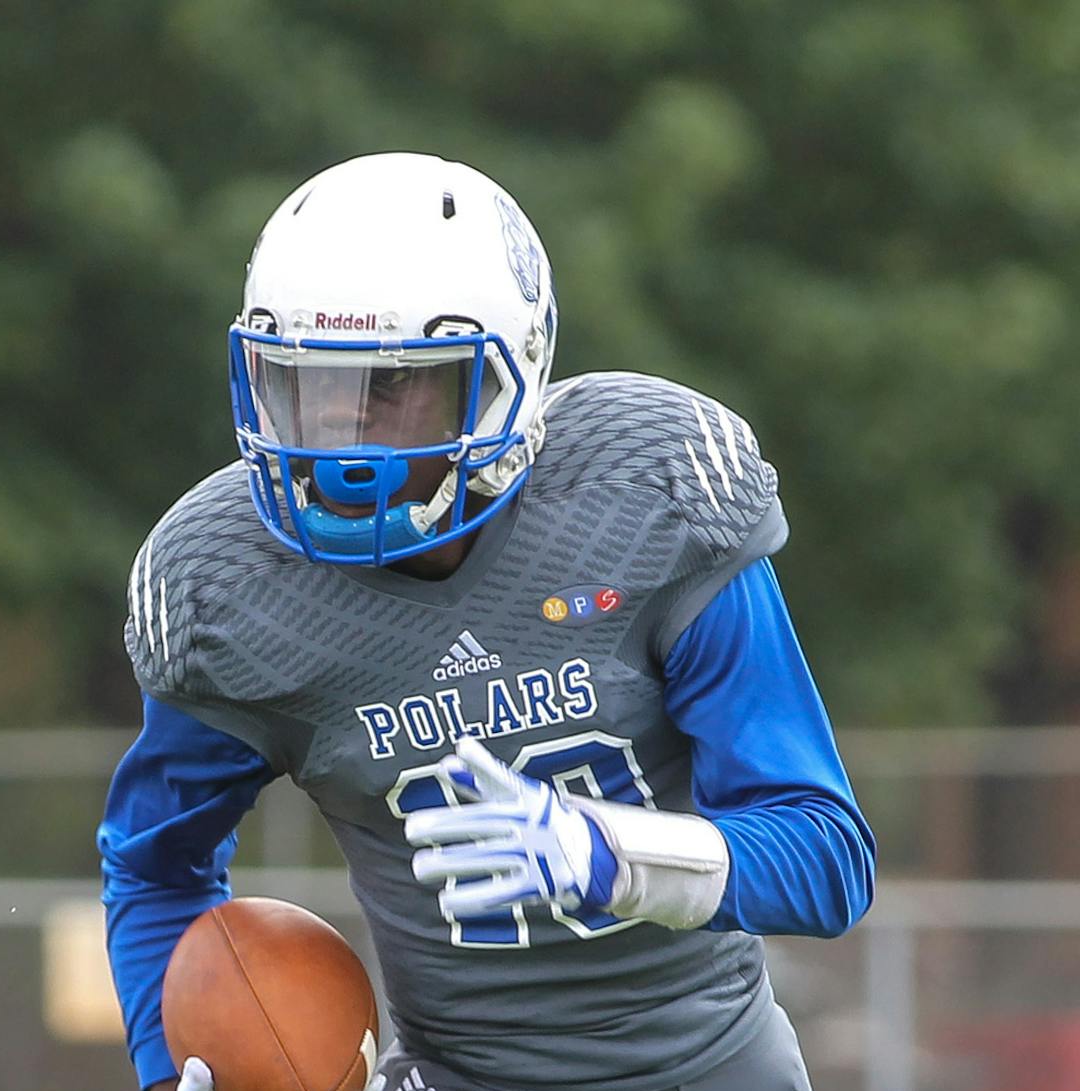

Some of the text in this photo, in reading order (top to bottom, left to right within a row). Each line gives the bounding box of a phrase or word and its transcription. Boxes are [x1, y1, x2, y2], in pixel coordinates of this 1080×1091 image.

[315, 312, 376, 330] Riddell
[432, 653, 502, 681] adidas
[356, 657, 598, 760] POLARS
